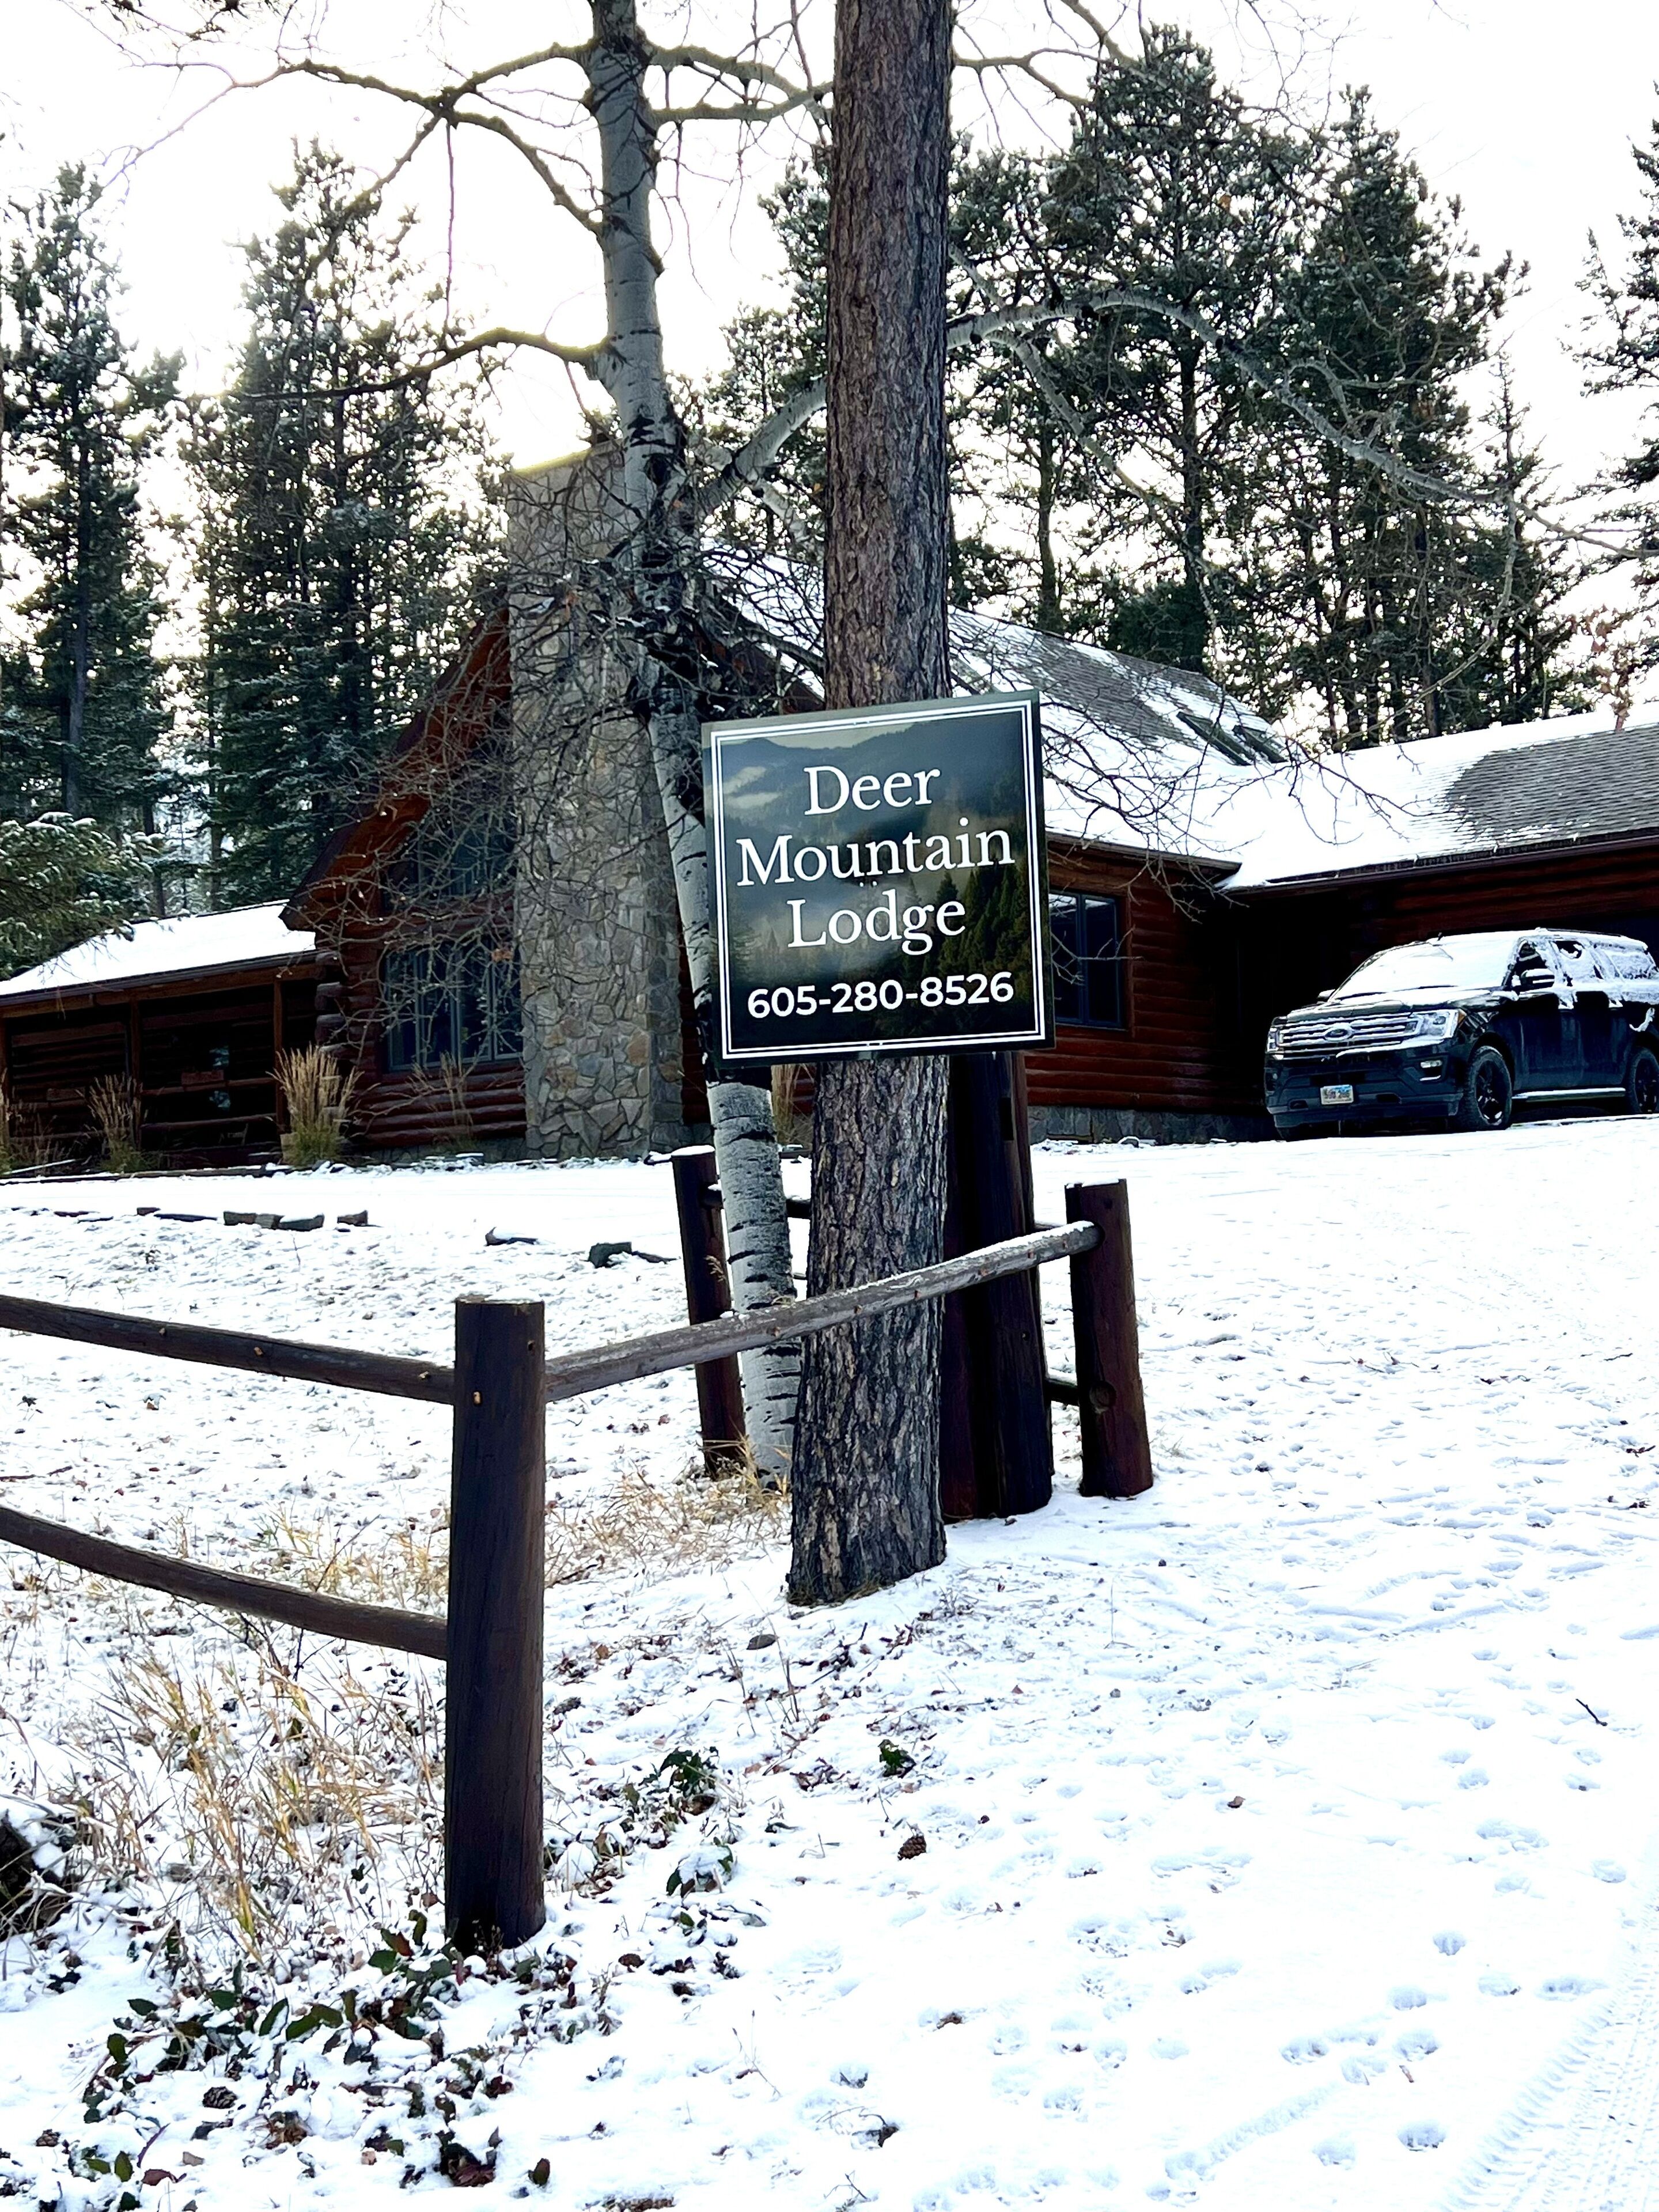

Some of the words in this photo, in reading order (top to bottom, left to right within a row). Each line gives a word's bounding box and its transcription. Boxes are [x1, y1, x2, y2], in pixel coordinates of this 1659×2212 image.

[804, 766, 941, 815] Deer
[736, 817, 1016, 887] Mountain
[786, 888, 965, 955] Lodge
[748, 971, 1014, 1018] 605-280-8526
